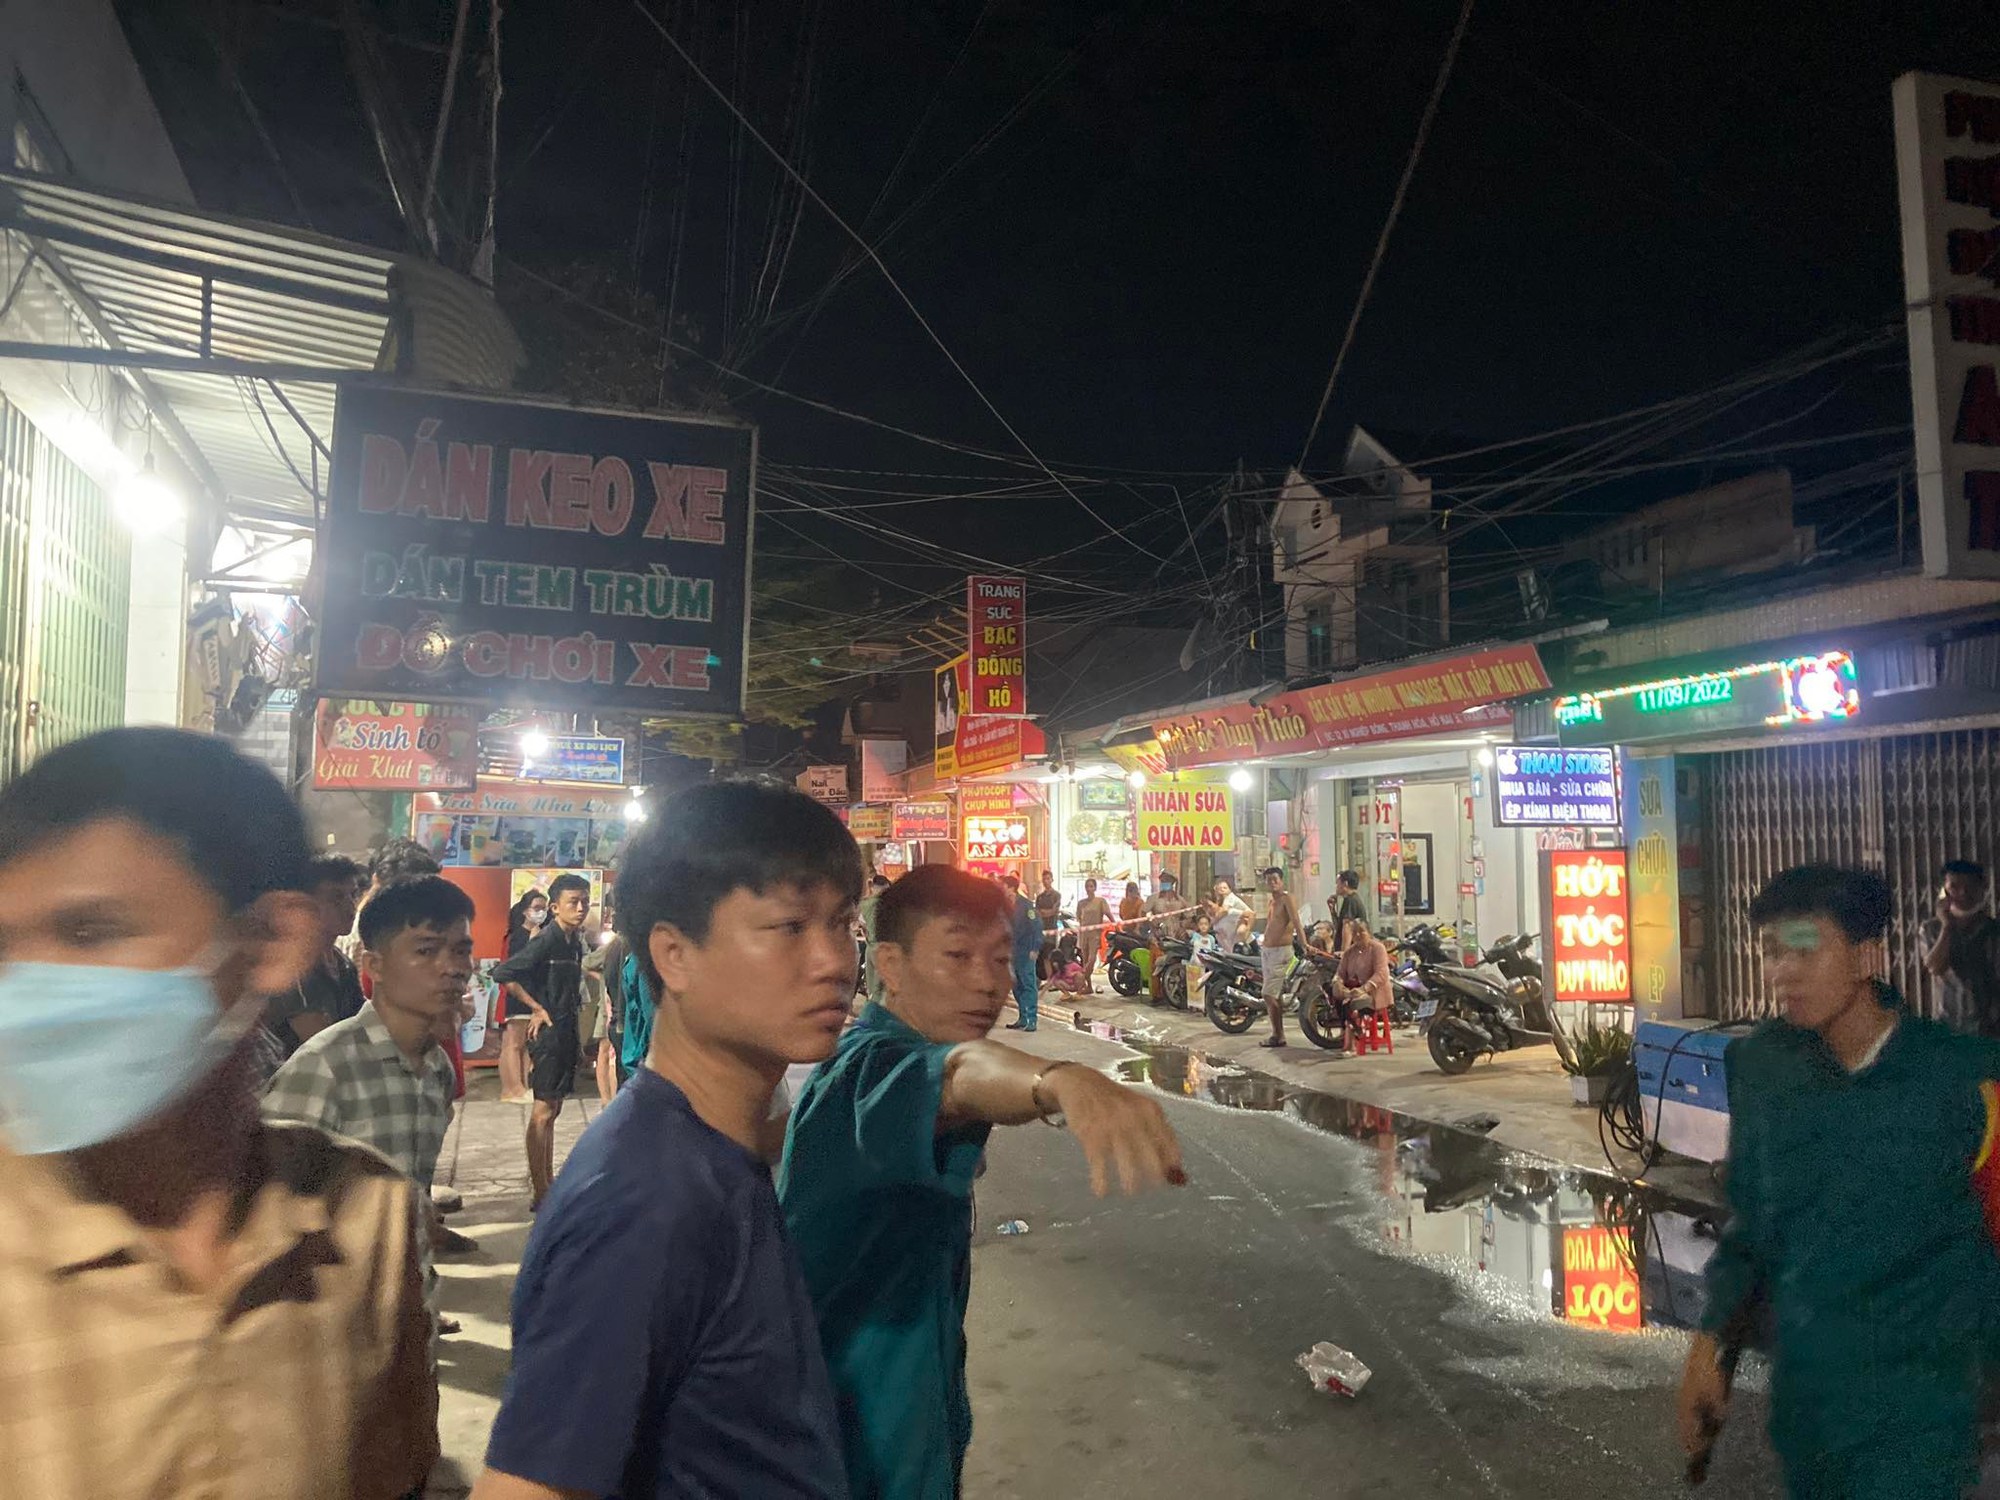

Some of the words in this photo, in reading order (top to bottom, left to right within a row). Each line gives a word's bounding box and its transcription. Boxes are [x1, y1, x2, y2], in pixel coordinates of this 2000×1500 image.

[358, 418, 494, 522] DÁN
[505, 447, 634, 536] KEO
[642, 459, 728, 544] XE
[361, 543, 466, 602] DÁN
[474, 558, 576, 611] TEM
[583, 563, 714, 622] TRÙM
[977, 583, 1021, 599] TRANG
[462, 630, 614, 685] CHƠI
[626, 641, 711, 692] XE
[988, 681, 1011, 708] HỒ
[1638, 677, 1732, 711] 11/09/2022
[352, 721, 411, 751] Sinh
[416, 722, 446, 751] tố
[1519, 752, 1563, 777] THOẠI
[1565, 753, 1611, 775] STORE
[961, 785, 1012, 798] PHOTOCOPY
[1500, 780, 1526, 796] MUA
[1527, 779, 1550, 796] BÁN
[969, 843, 997, 858] AN
[1000, 843, 1029, 858] AN
[1556, 905, 1625, 948] TÓC
[1557, 960, 1585, 994] DUY
